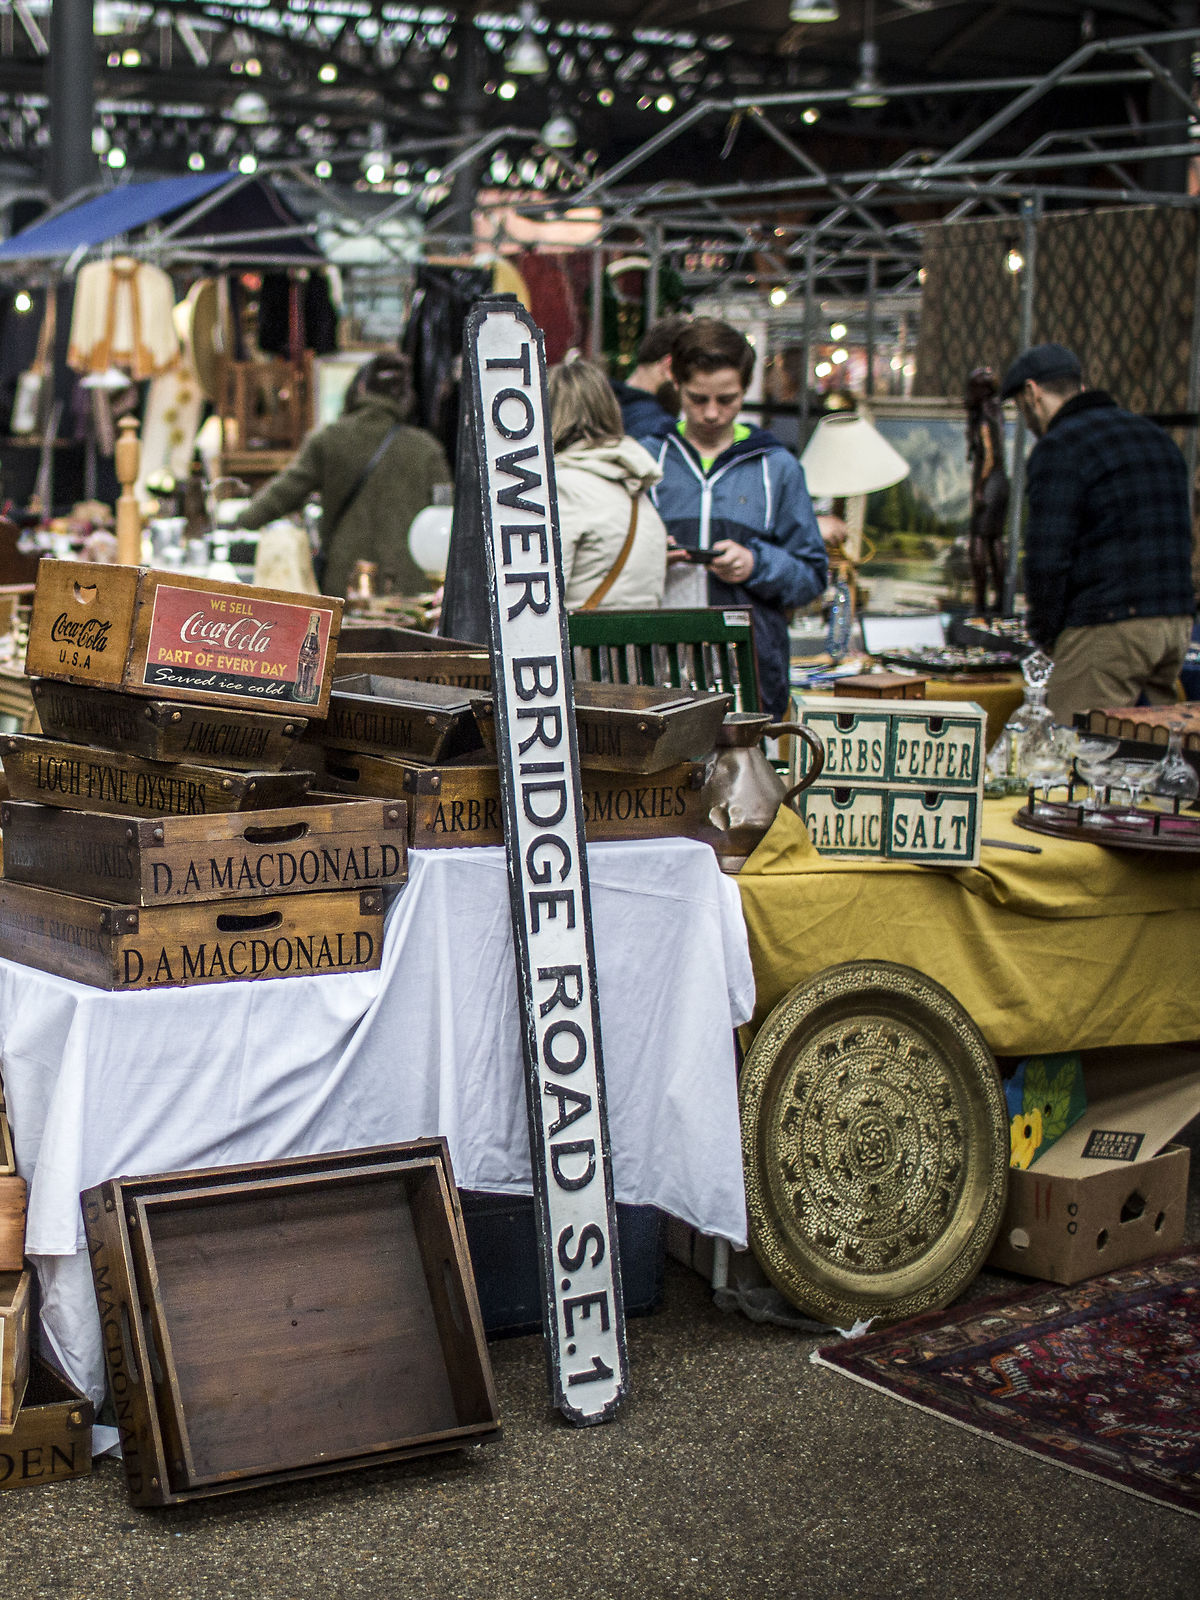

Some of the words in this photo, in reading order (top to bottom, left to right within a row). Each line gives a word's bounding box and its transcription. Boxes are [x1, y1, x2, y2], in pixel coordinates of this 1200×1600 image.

[485, 343, 551, 622] TOWER
[210, 599, 227, 613] WE
[229, 602, 253, 616] SELL
[51, 612, 112, 653] Coca-Cola
[180, 611, 277, 653] Coca-Cola
[154, 668, 216, 685] Served
[218, 677, 244, 691] ice
[247, 682, 286, 696] cold
[158, 648, 192, 664] PART
[195, 652, 213, 668] OF
[216, 655, 258, 674] EVERY
[260, 661, 287, 677] DAY
[897, 739, 971, 778] PEPPER
[37, 755, 80, 795] LOCH
[86, 764, 128, 804] FYNE
[136, 773, 206, 815] OYSTERS
[512, 655, 577, 935] BRIDGE
[582, 786, 686, 822] SMOKIES
[807, 813, 879, 847] GARLIC
[893, 815, 966, 850] SALT
[152, 861, 200, 896] D.A
[209, 844, 401, 889] MACDONALD
[121, 946, 174, 984] D.A
[180, 930, 374, 978] MACDONALD
[537, 965, 596, 1192] ROAD
[557, 1224, 614, 1387] S.E.1
